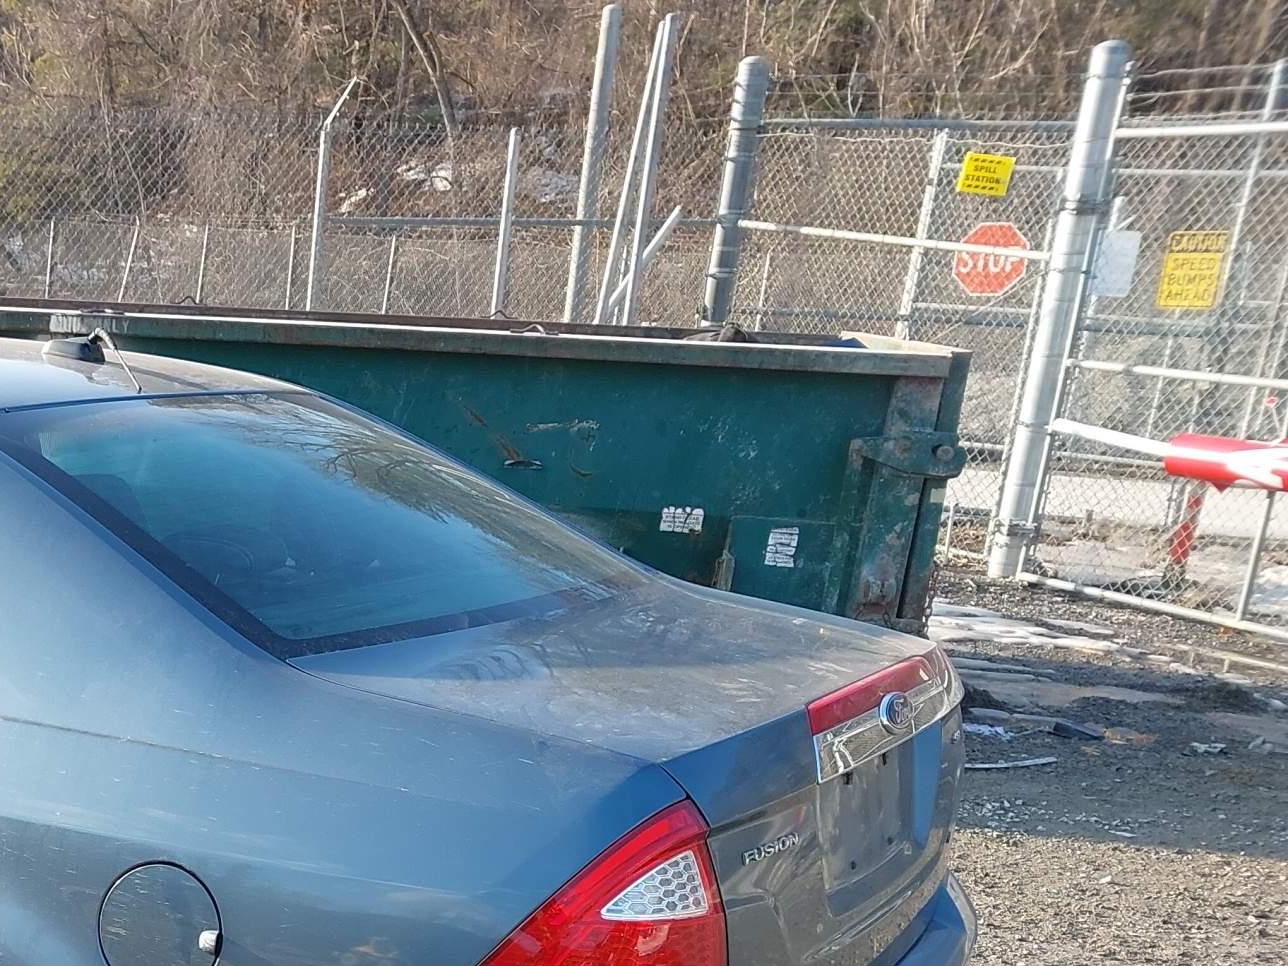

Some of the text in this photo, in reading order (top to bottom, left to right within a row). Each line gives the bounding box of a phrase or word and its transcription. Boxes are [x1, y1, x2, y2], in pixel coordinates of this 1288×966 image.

[973, 163, 998, 174] SPILL
[964, 174, 1001, 185] STATION
[1171, 257, 1217, 271] SPEED
[1167, 273, 1216, 287] BUMPS
[1164, 289, 1211, 302] AHEAD
[742, 831, 799, 865] FUSION
